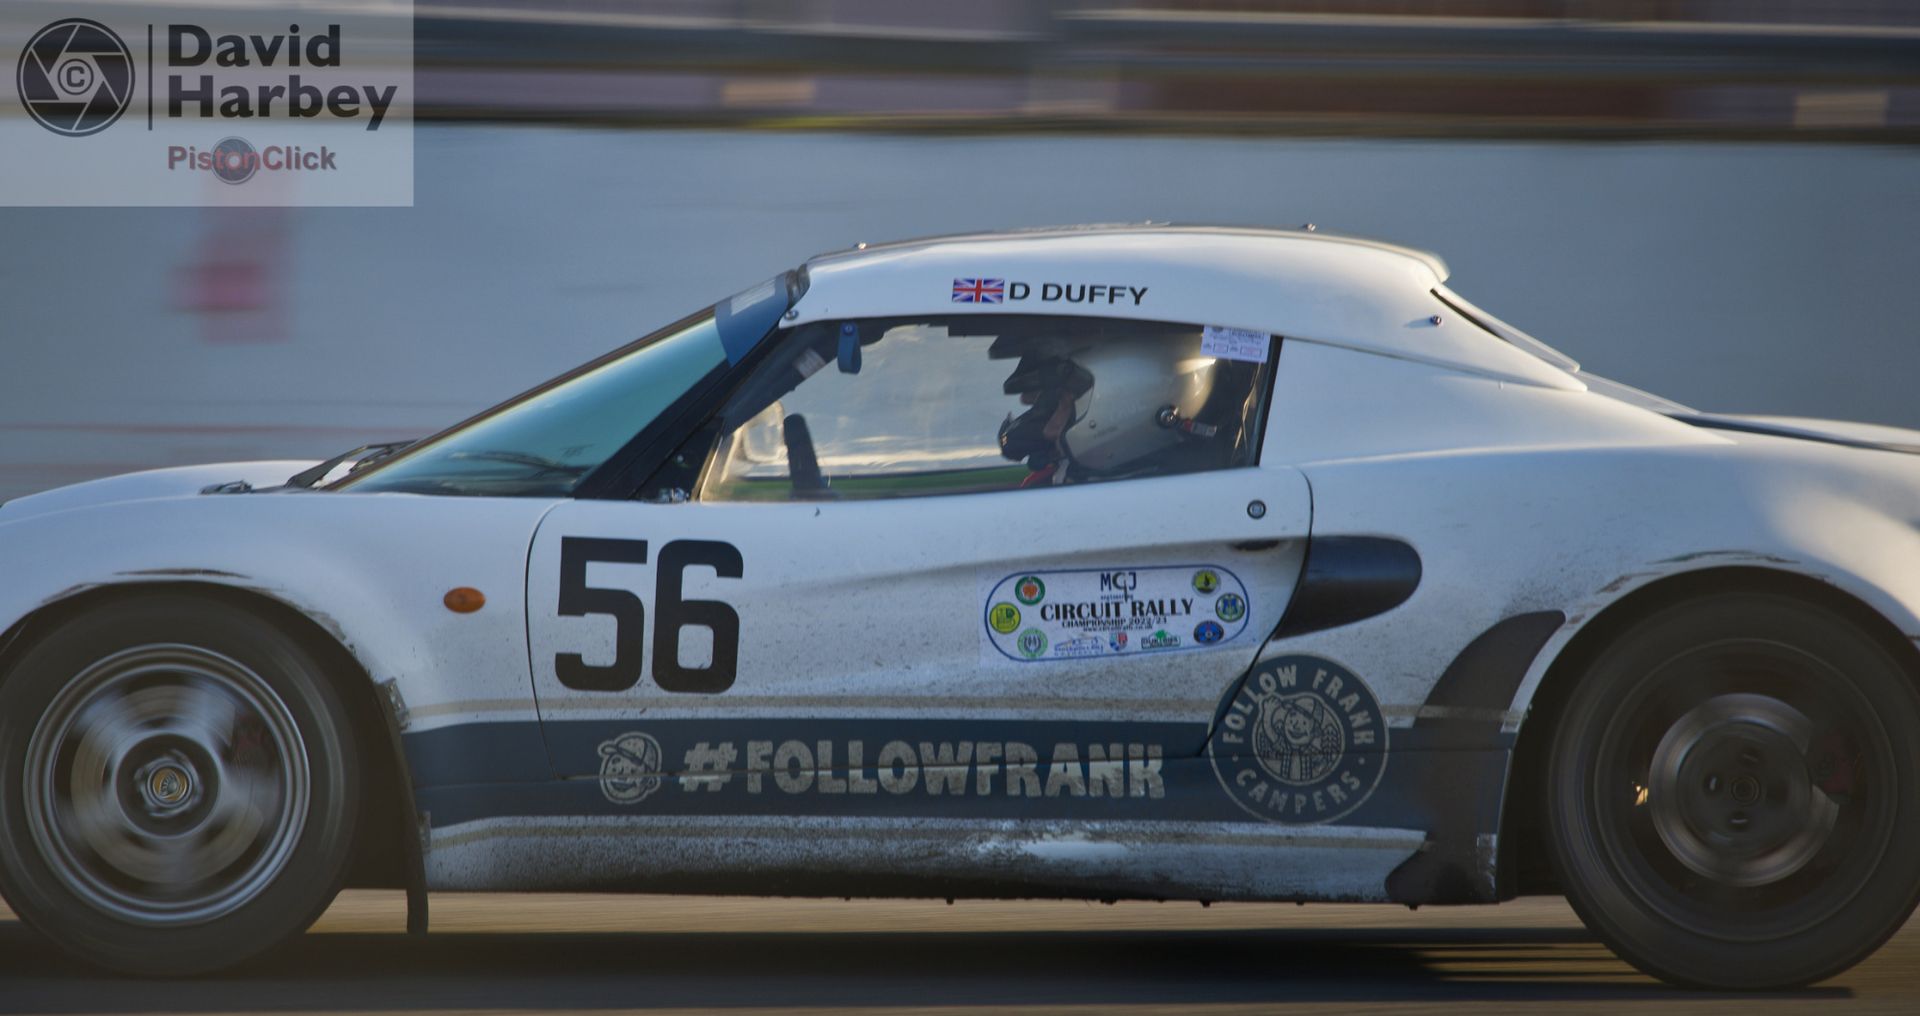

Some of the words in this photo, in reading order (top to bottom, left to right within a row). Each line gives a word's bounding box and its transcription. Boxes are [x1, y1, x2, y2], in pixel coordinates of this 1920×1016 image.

[1009, 282, 1030, 300] D
[1041, 283, 1148, 306] DUFFY
[554, 536, 744, 694] 56
[1040, 601, 1124, 622] CIRCUIT
[1131, 598, 1194, 617] RALLY
[1061, 617, 1127, 629] CHAMPIONSHIP
[1222, 664, 1298, 744] FOLLOW
[1311, 667, 1375, 745] FRANK
[1236, 770, 1361, 815] CAMPERS
